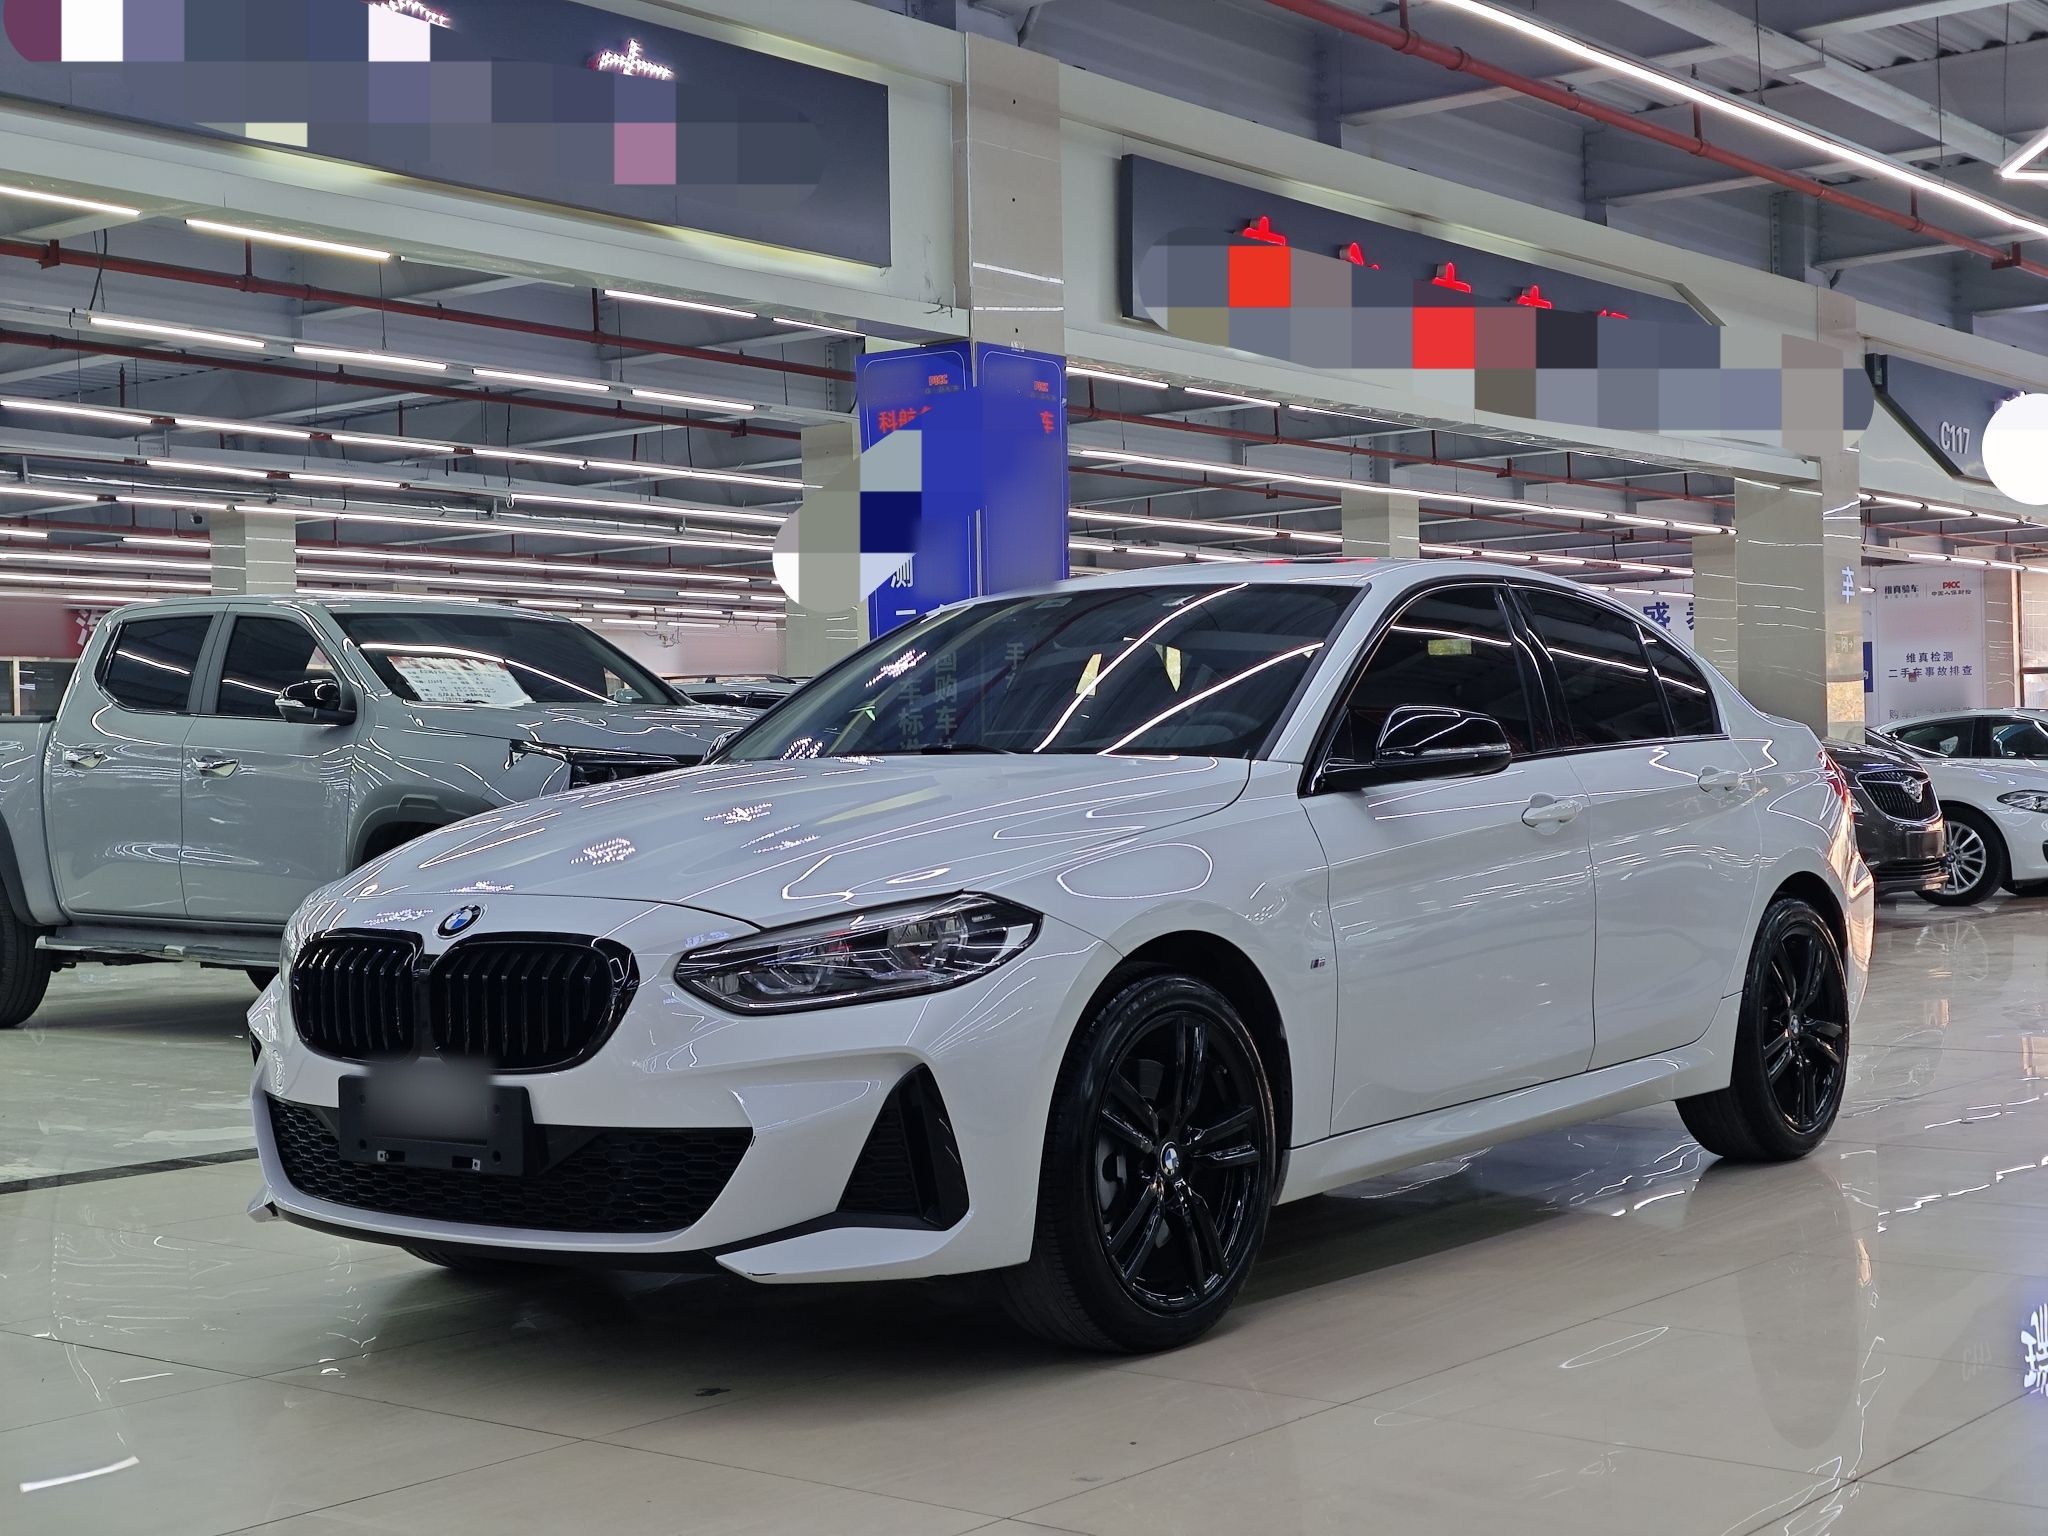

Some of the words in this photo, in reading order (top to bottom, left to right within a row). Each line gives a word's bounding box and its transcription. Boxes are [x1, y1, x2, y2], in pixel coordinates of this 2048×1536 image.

[879, 405, 933, 433] 科航
[1940, 421, 1971, 455] C117
[1942, 580, 1961, 589] PICC
[1905, 651, 1954, 664] 维真检测
[1888, 664, 1973, 680] 二手车事故排查
